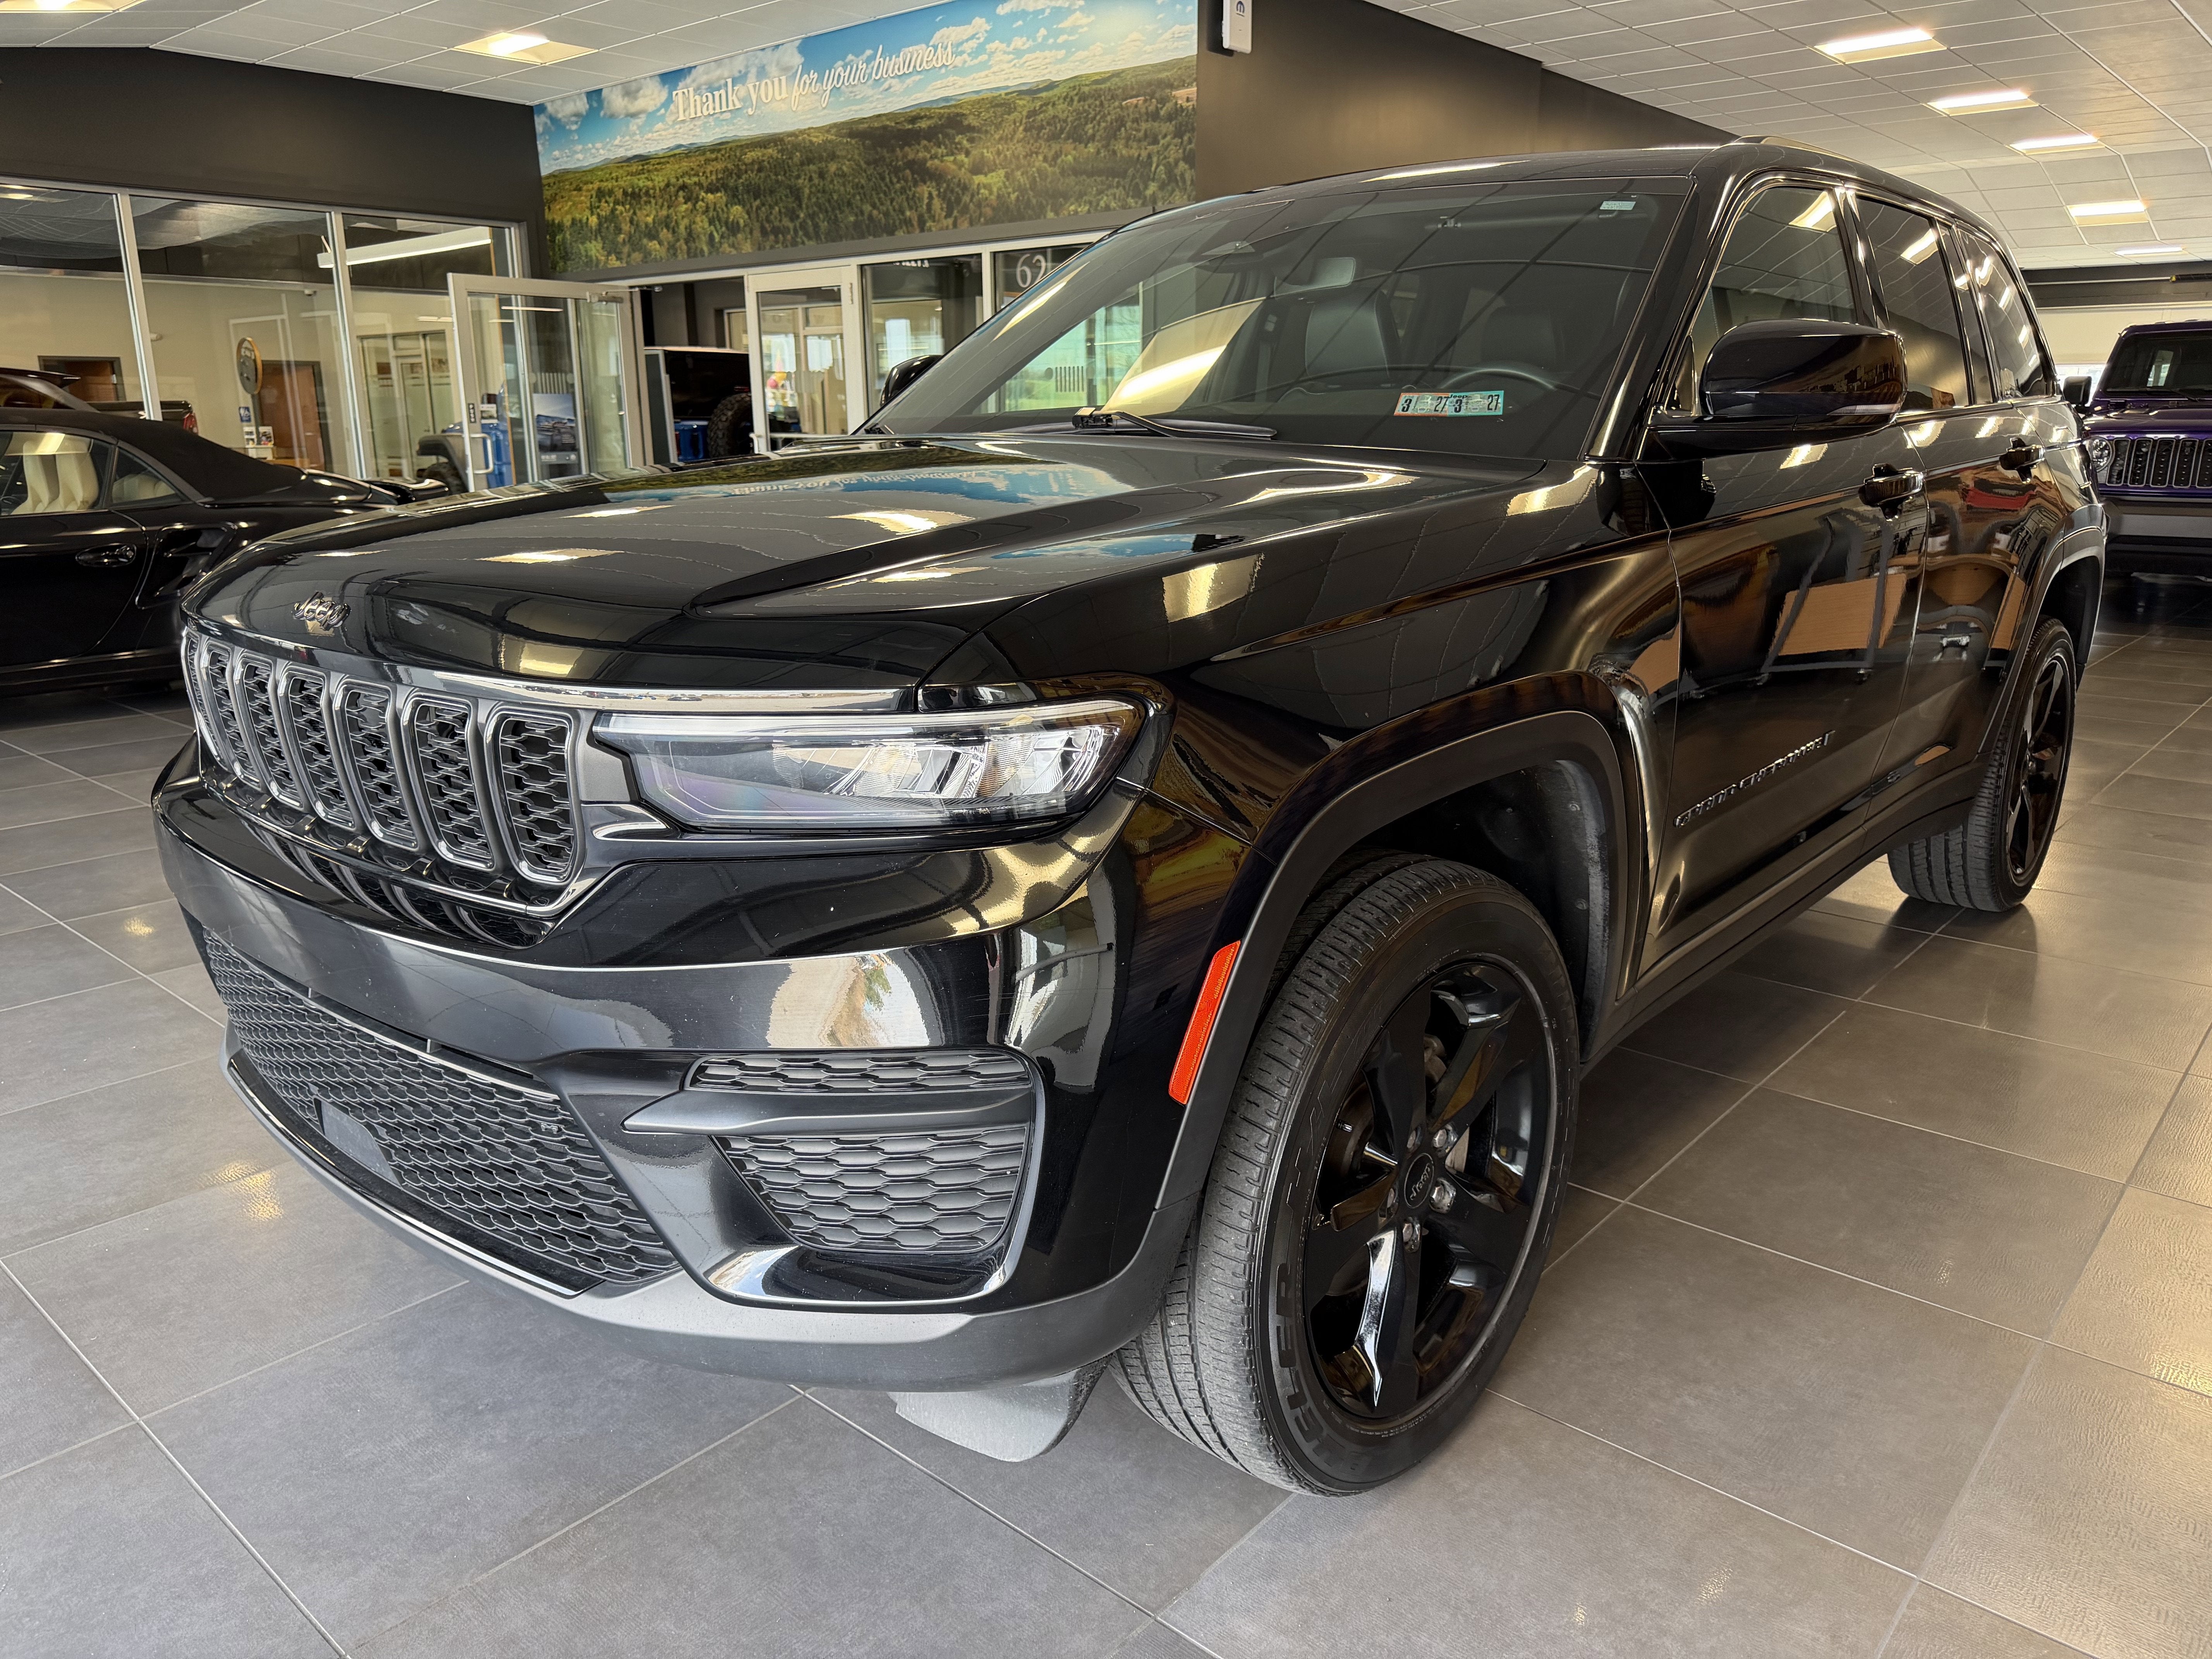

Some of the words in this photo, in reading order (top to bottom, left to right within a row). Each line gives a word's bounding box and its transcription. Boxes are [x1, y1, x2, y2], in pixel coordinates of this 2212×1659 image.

[672, 79, 742, 122] Thank
[746, 76, 789, 115] you
[791, 64, 821, 112] for
[821, 62, 868, 108] your
[871, 40, 957, 80] business
[1401, 398, 1412, 412] 3
[1434, 396, 1450, 412] 27
[1454, 399, 1463, 413] 3
[1487, 394, 1500, 411] 27
[291, 591, 352, 631] Jeep
[1410, 1163, 1431, 1200] Jeep
